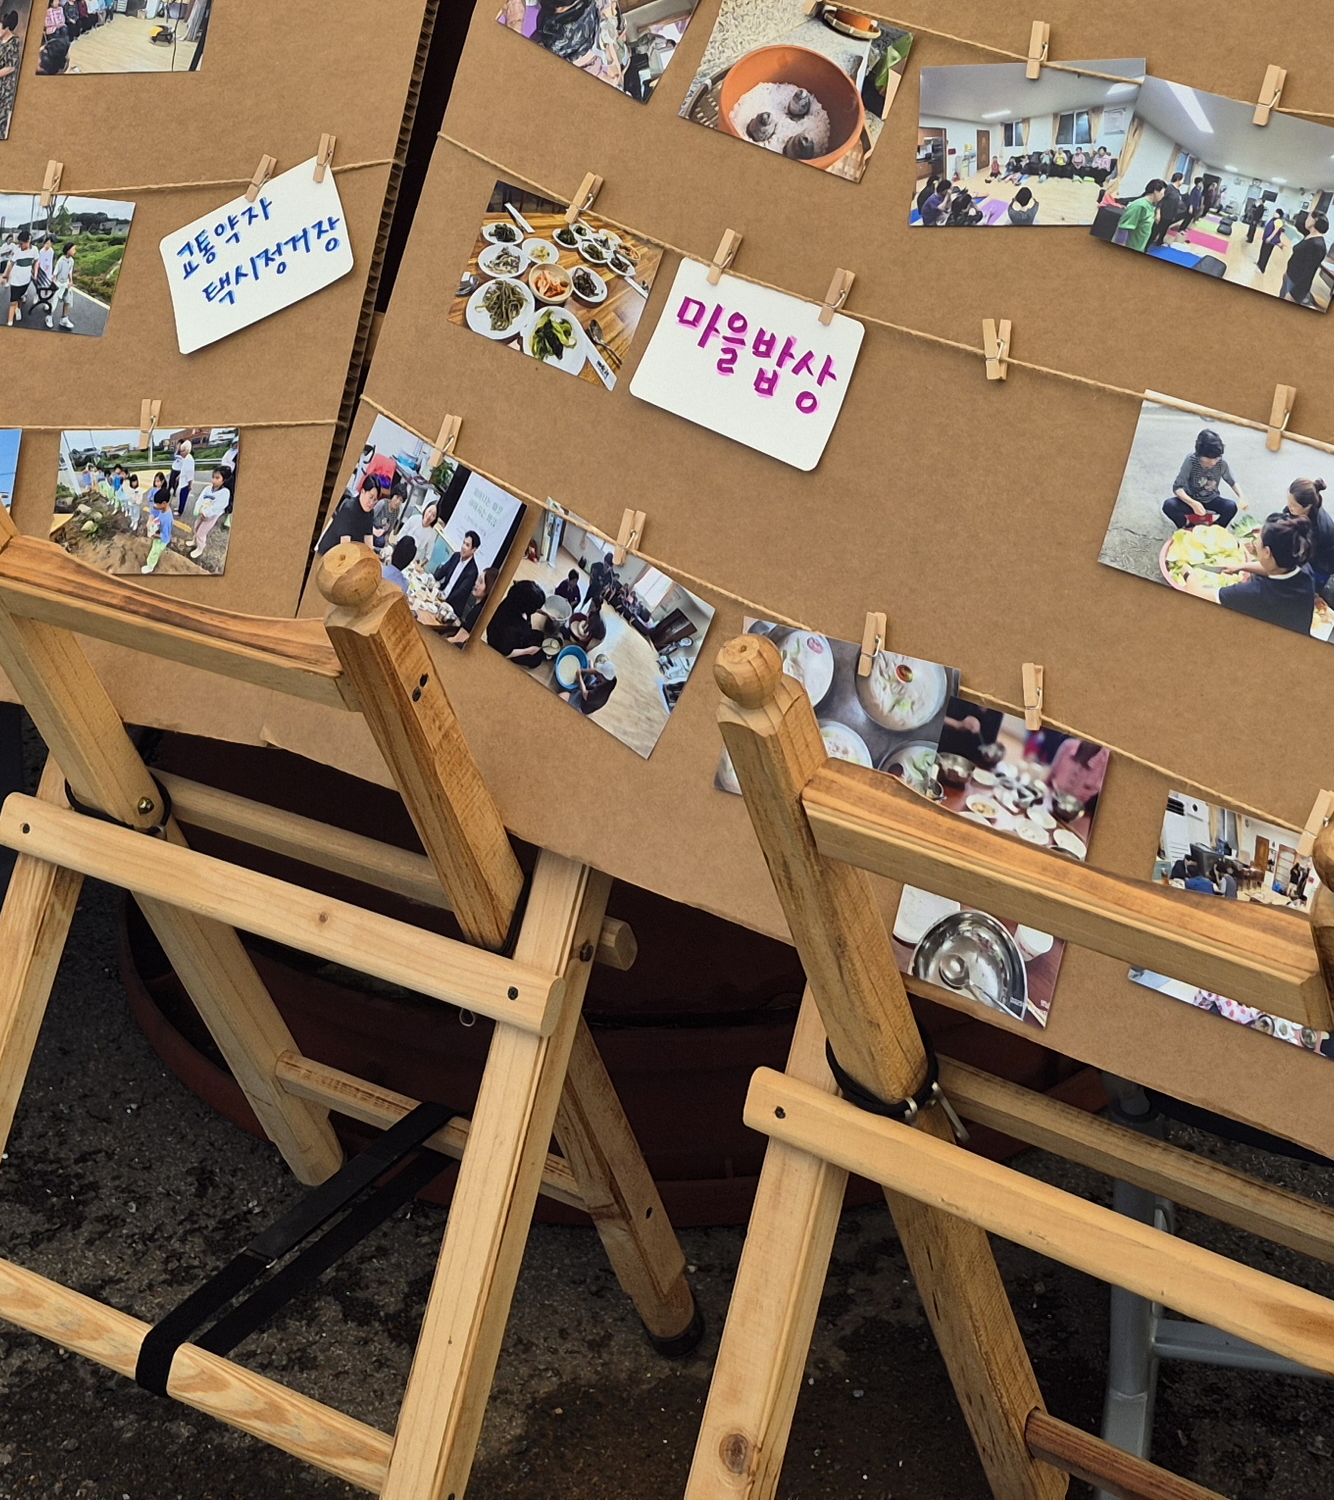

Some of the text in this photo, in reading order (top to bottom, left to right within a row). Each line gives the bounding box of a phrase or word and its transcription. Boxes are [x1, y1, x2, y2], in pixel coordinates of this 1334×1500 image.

[176, 197, 273, 280] 교통약자
[202, 216, 341, 305] 택시정거장
[676, 295, 838, 415] 마을밥상
